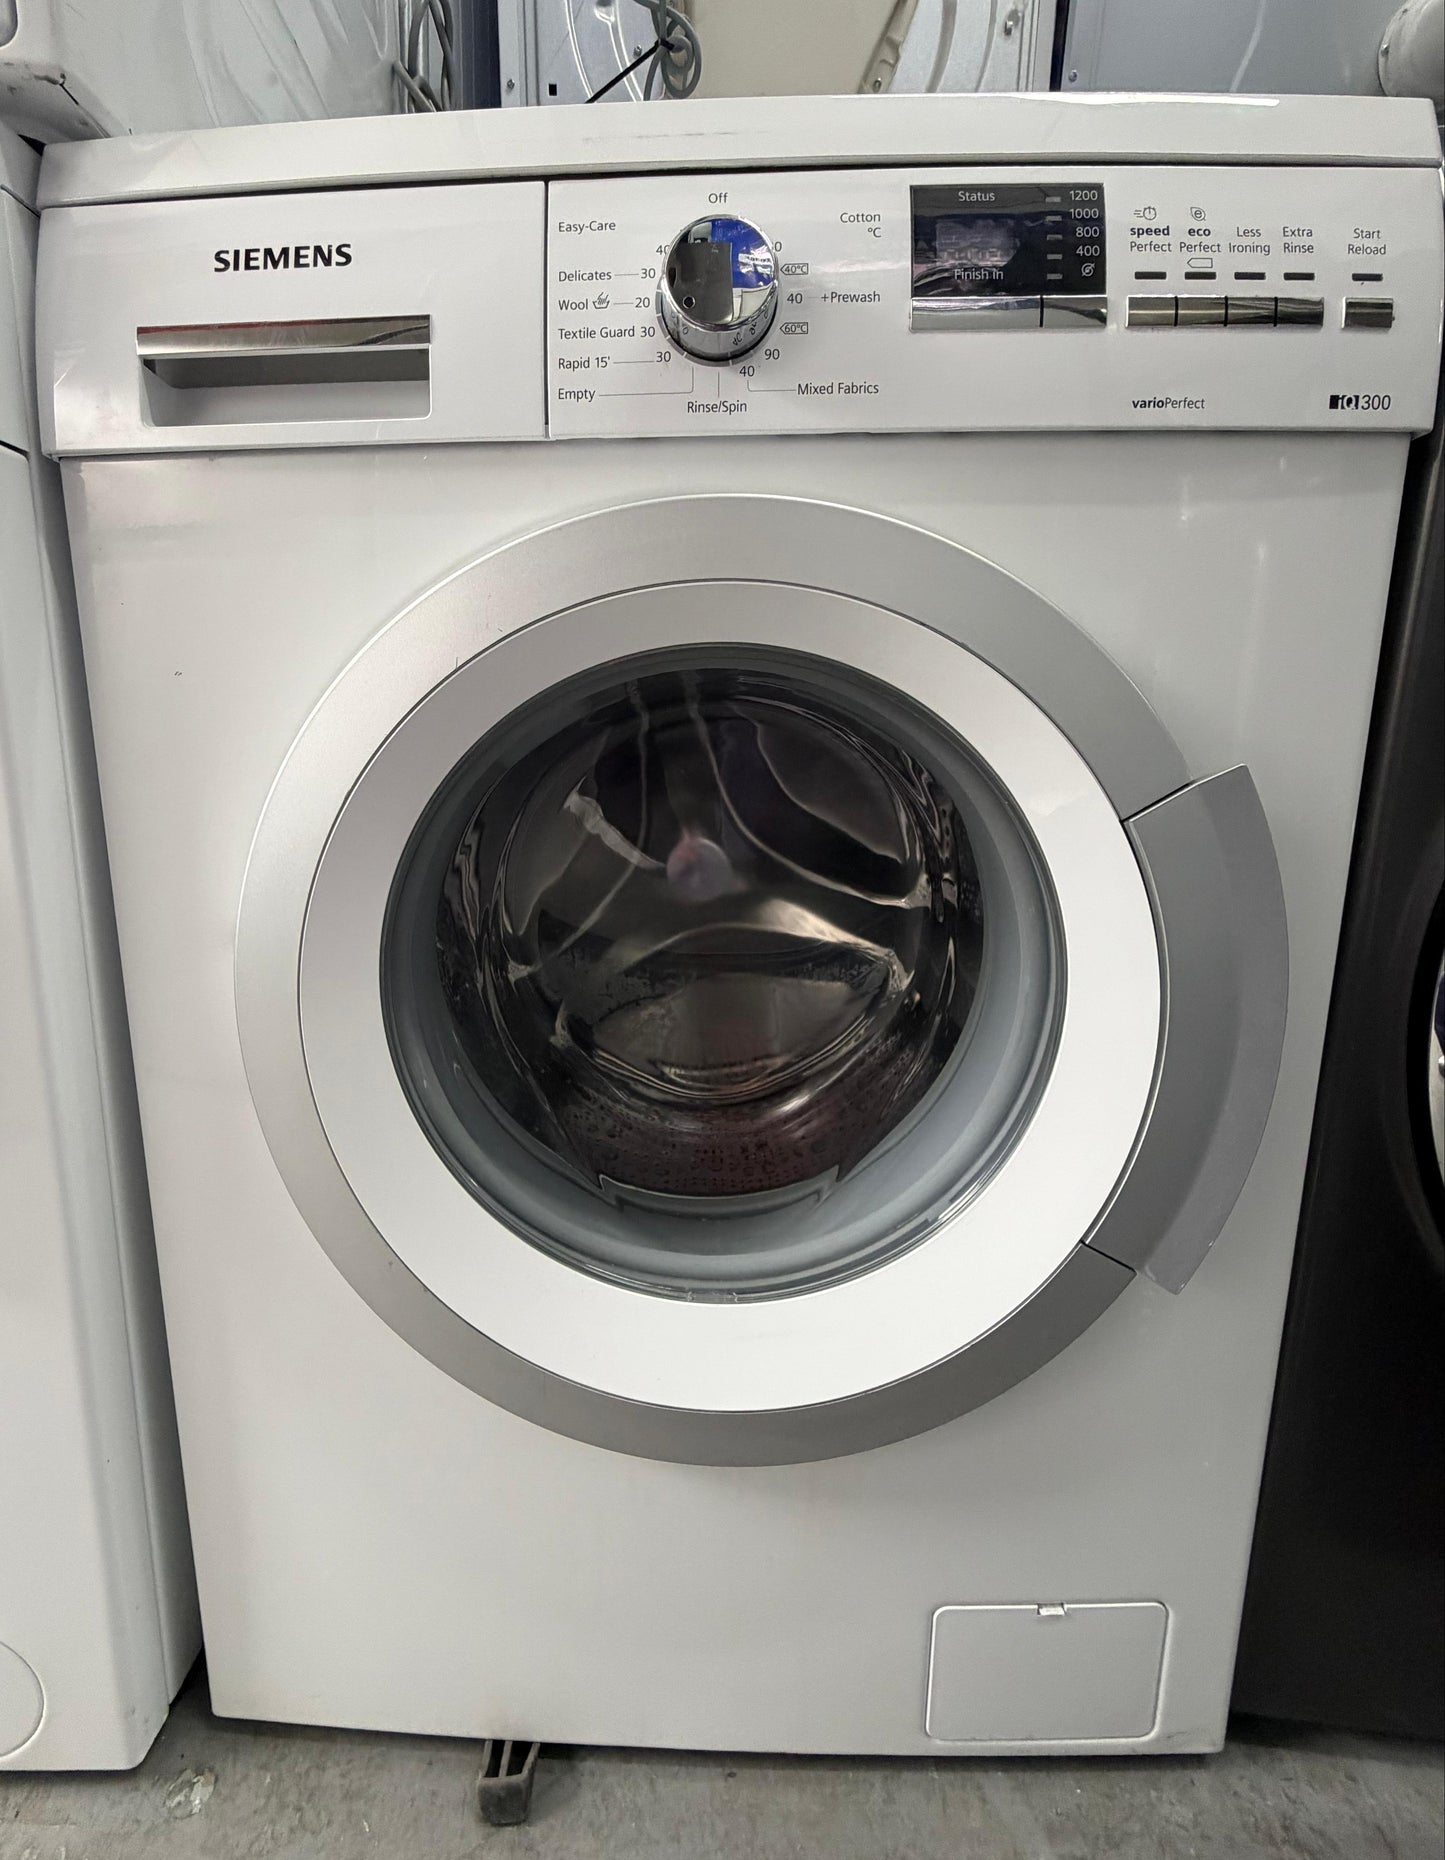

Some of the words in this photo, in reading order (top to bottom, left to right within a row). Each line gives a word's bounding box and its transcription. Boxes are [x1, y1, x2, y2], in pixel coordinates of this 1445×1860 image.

[708, 192, 728, 204] Off
[958, 190, 996, 202] Status
[1069, 190, 1098, 201] 1200
[840, 212, 881, 224] Cotton
[1069, 208, 1100, 219] 1000
[558, 220, 617, 235] Easy-Care
[1075, 227, 1100, 238] 800
[1130, 225, 1170, 238] speed
[1188, 228, 1211, 237] eco
[1236, 226, 1262, 238] Less
[1282, 226, 1313, 238] Extra
[1353, 228, 1381, 239] Start
[1076, 245, 1100, 256] 400
[1129, 241, 1172, 253] Perfect
[1179, 242, 1221, 253] Perfect
[1228, 242, 1271, 256] Ironing
[1283, 242, 1314, 254] Rinse
[1348, 244, 1387, 255] Reload
[214, 243, 353, 273] SIEMENS
[558, 270, 612, 282] Delicates
[640, 268, 656, 279] 30
[954, 267, 989, 280] Finish
[993, 268, 1004, 280] in
[558, 299, 589, 310] Wool
[635, 297, 650, 308] 20
[786, 293, 803, 304] 40
[558, 327, 597, 339] Textile
[600, 326, 635, 338] Guard
[640, 327, 656, 338] 30
[764, 348, 780, 360] 90
[558, 357, 590, 372] Rapid
[656, 351, 671, 362] 30
[739, 365, 755, 377] 40
[797, 382, 834, 395] Mixed
[838, 381, 879, 394] Fabrics
[558, 388, 596, 402] Empty
[687, 400, 747, 415] Rinse/Spin
[1132, 397, 1205, 409] varioPerfect
